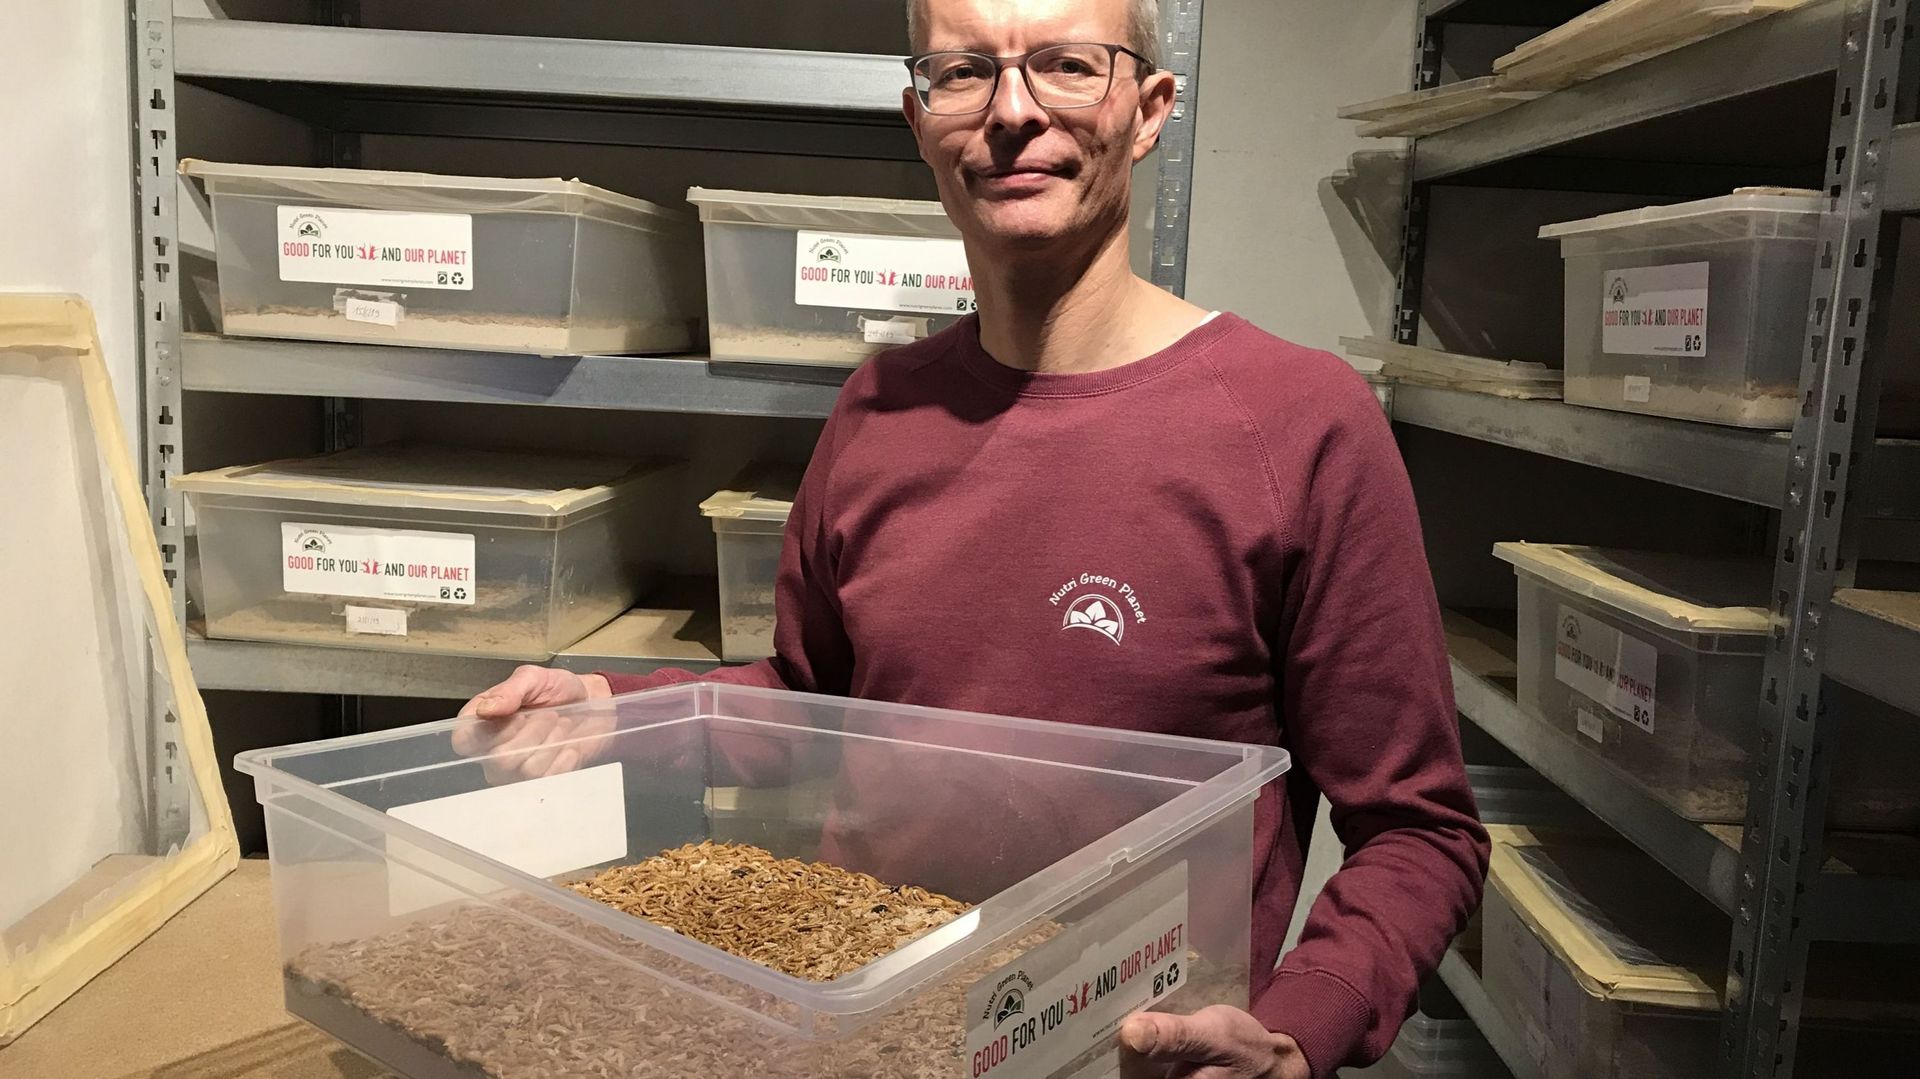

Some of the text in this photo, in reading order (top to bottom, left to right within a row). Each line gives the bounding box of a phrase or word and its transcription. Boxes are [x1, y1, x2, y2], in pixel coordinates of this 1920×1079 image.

[283, 242, 466, 265] GOOD FOR YOU AND OUR PLANET
[801, 266, 976, 291] GOOD FOR YOU AND OUR PLAN
[1619, 310, 1630, 326] FOR
[1630, 310, 1641, 326] YOU
[1654, 309, 1666, 326] AND
[1667, 308, 1679, 326] OUR
[1680, 308, 1704, 326] PLANET
[288, 555, 470, 582] GOOD FOR YOU AND OUR PLANET
[1049, 572, 1146, 624] Nutri Green Planet
[1629, 678, 1652, 704] PLANET
[972, 1034, 1008, 1079] GOOD
[1012, 1016, 1036, 1054] FOR
[1040, 998, 1064, 1036] YOU
[1094, 965, 1118, 1002] AND
[1120, 950, 1142, 984] OUR
[1144, 923, 1183, 970] PLANET
[982, 970, 1033, 1020] Nutri Green Planet
